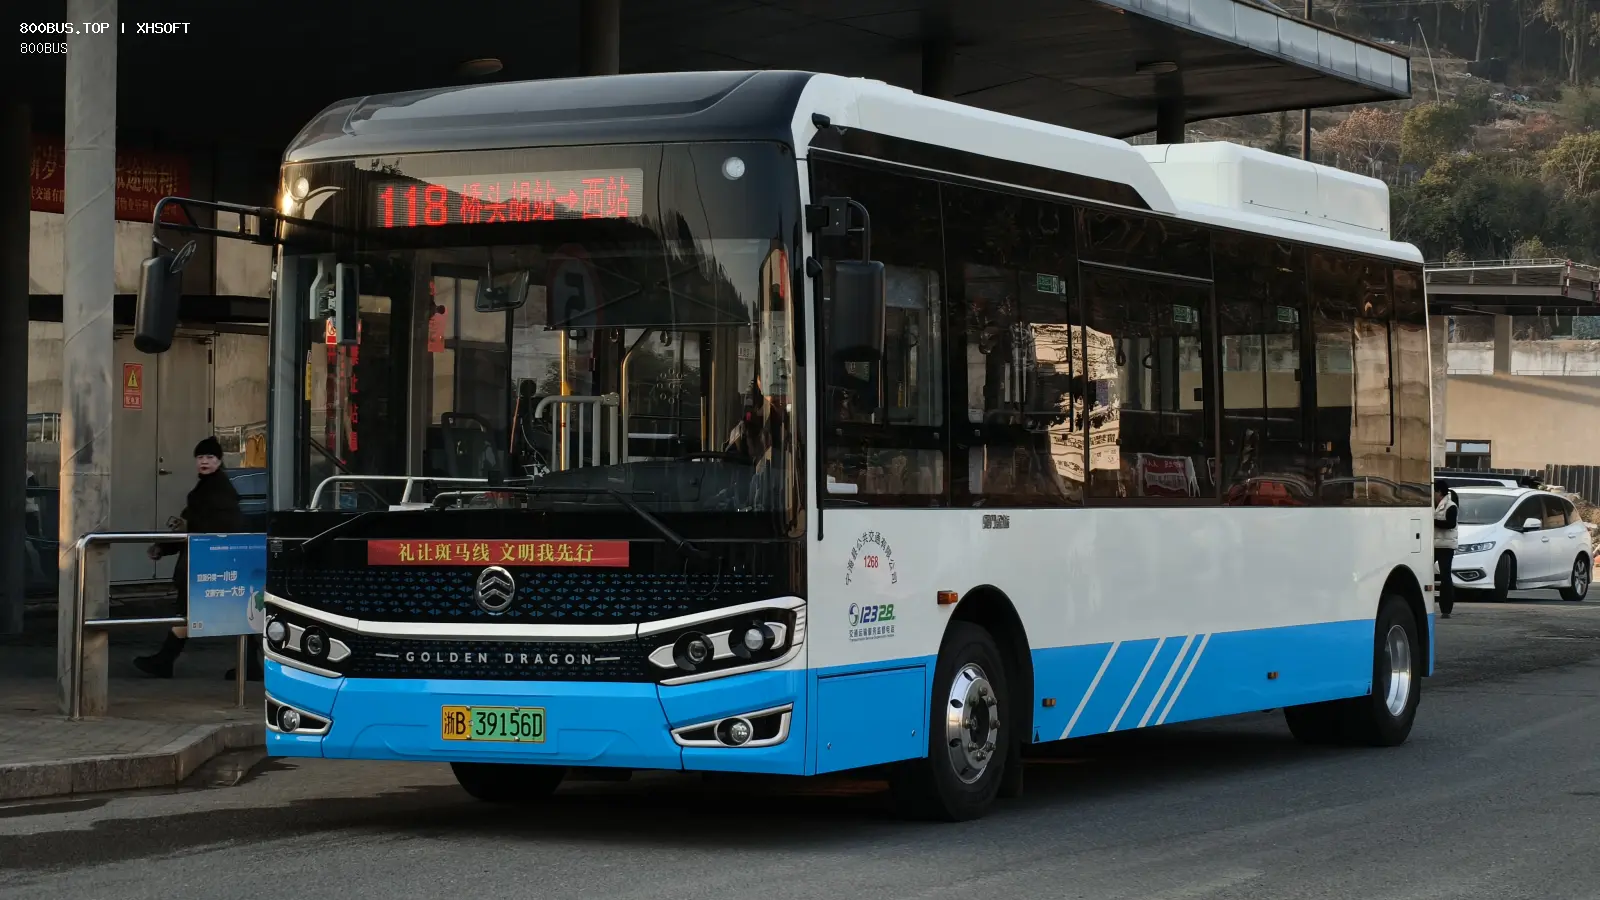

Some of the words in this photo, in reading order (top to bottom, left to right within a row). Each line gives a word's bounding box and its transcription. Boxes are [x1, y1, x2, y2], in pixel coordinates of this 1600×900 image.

[380, 185, 447, 228] 118
[581, 176, 631, 219] 西站
[398, 543, 490, 562] 礼让斑马线
[499, 543, 594, 563] 文明我先行
[845, 530, 898, 586] 宁海县公共交通有限公司
[864, 556, 879, 568] 1268
[860, 604, 894, 623] 12328
[405, 651, 488, 663] GOLDEN
[504, 653, 592, 665] DRAGON
[444, 711, 466, 735] 浙B
[475, 712, 543, 737] 39156D
